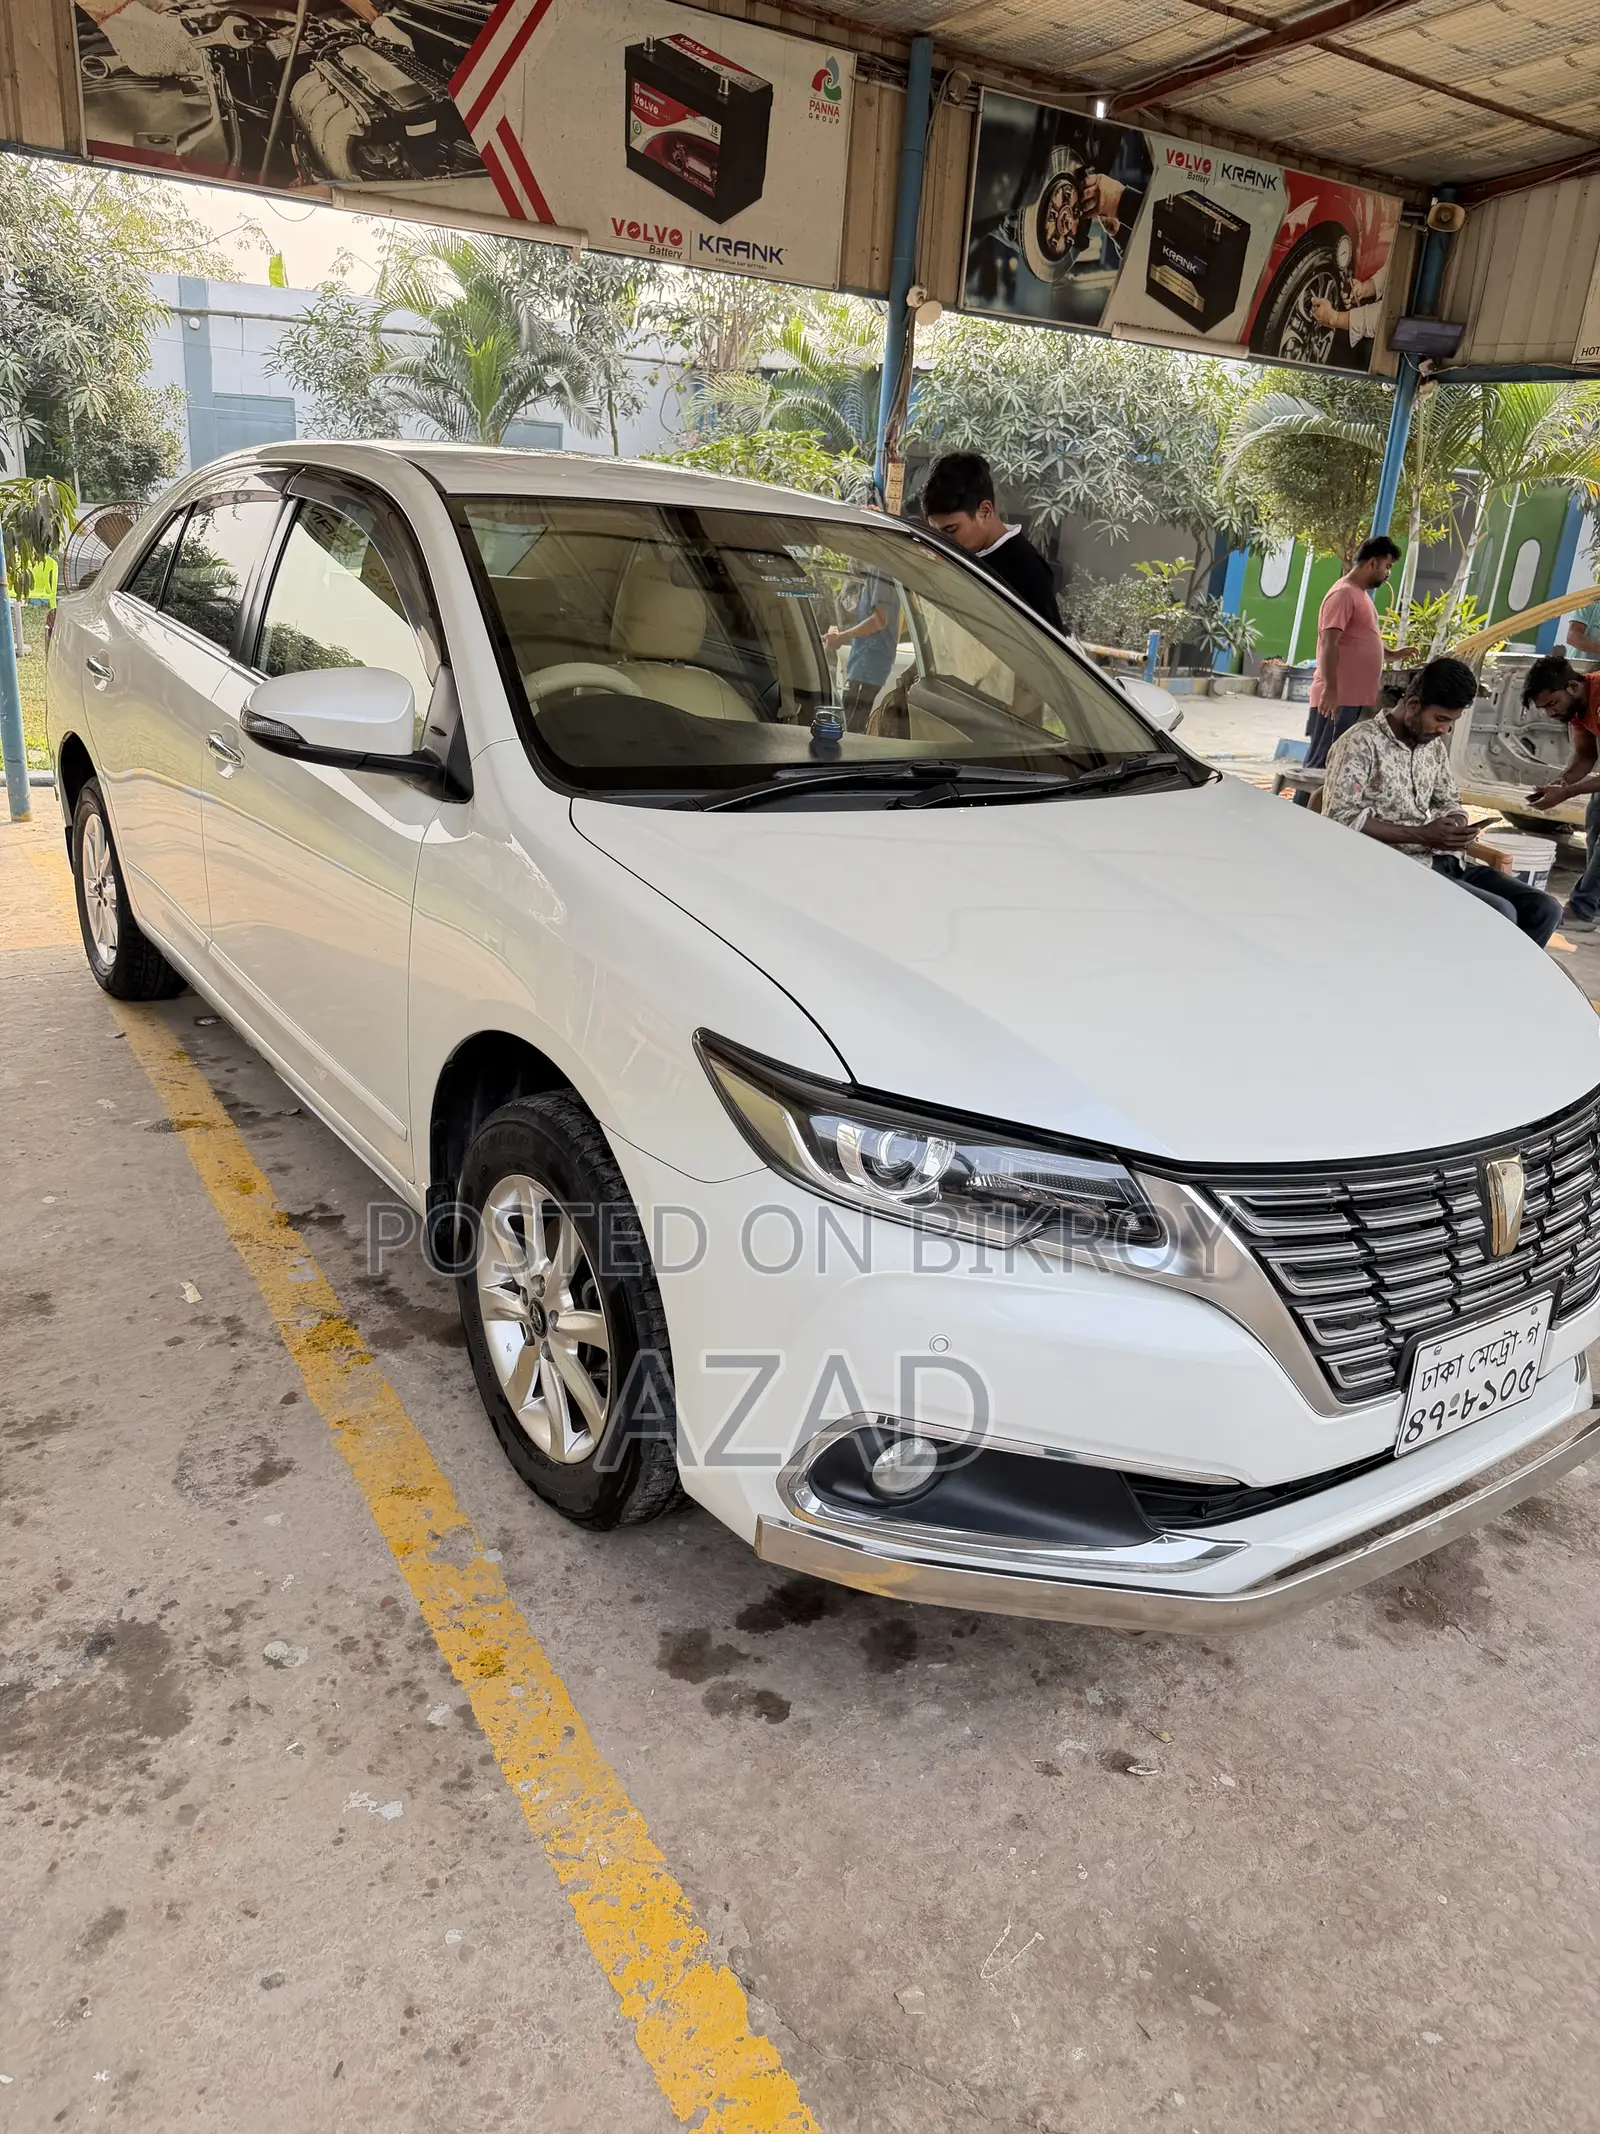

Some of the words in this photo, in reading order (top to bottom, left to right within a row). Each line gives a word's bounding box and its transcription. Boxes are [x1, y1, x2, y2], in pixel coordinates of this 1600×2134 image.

[678, 37, 709, 55] VOLVO
[633, 94, 659, 116] VOLVO
[809, 100, 840, 118] PANNA
[808, 112, 840, 125] GROUP
[1166, 148, 1212, 174] VOLVO
[1187, 171, 1210, 186] Battery
[1221, 163, 1279, 191] KRANK
[611, 217, 683, 247] VOLVO
[649, 244, 683, 260] Battery
[699, 233, 785, 266] KRANK
[1162, 245, 1197, 274] KRANK
[1421, 1353, 1465, 1392] ঢাকা
[1404, 1360, 1536, 1444] ৪৭-৮১০৫
